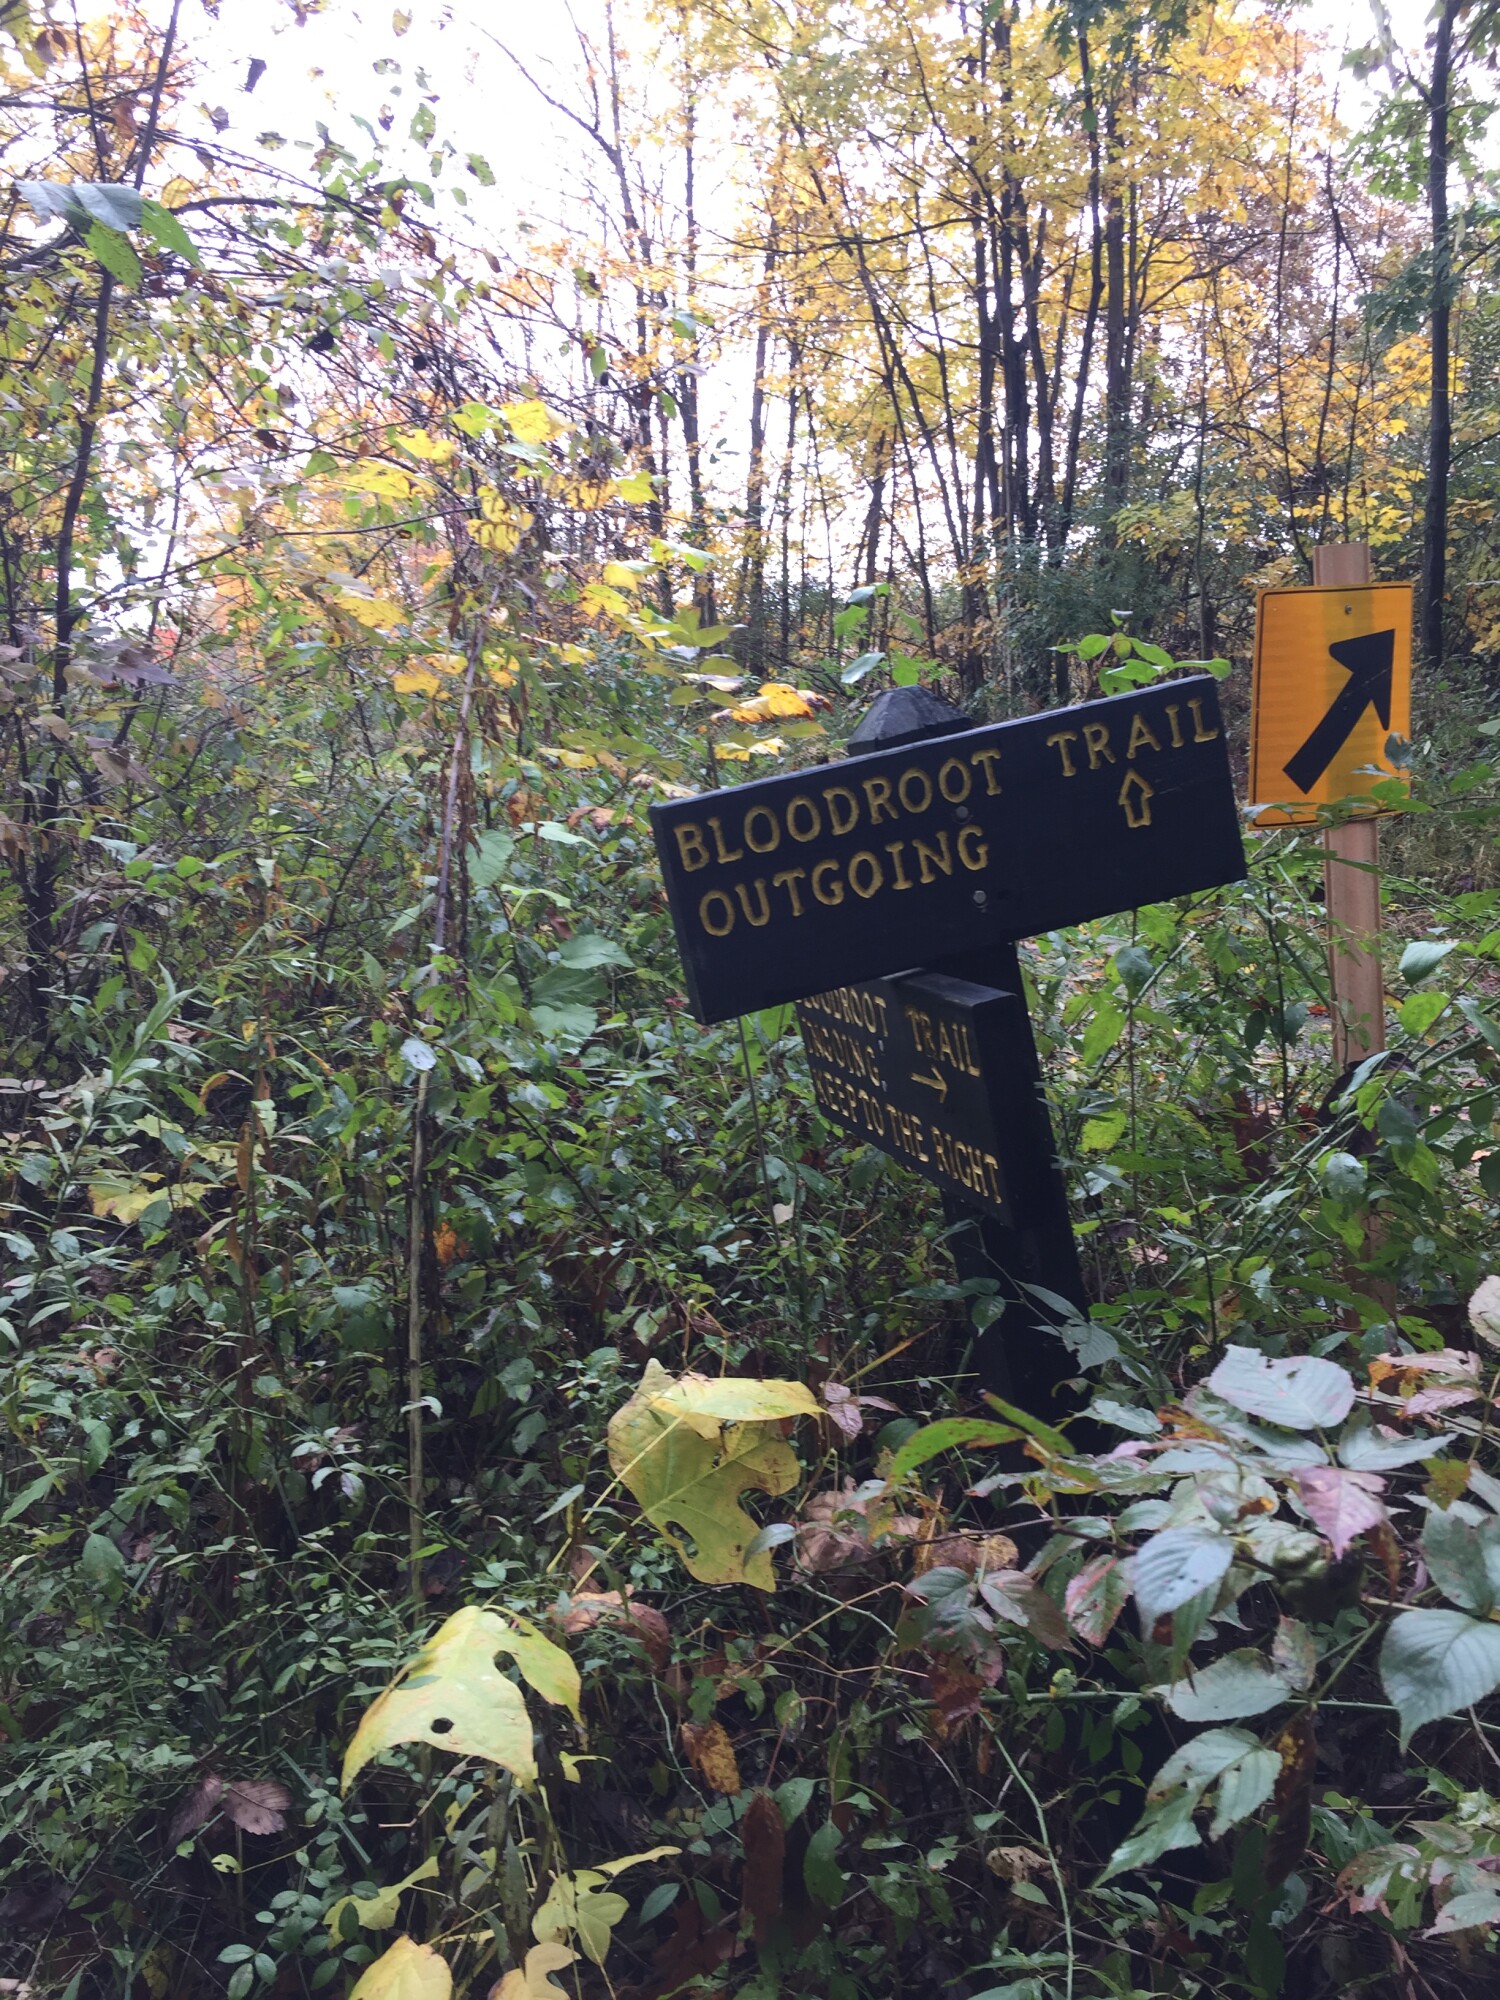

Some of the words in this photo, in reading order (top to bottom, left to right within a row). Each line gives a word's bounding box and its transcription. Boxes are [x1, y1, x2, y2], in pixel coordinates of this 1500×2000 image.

[673, 748, 1002, 873] BLOODROOT
[1046, 697, 1221, 777] TRAIL
[698, 825, 990, 937] OUTGOING
[905, 1005, 981, 1078] TRAIL
[813, 1068, 858, 1123] KEEP
[858, 1088, 885, 1137] TO
[886, 1103, 930, 1163] THE
[931, 1125, 1002, 1204] RIGHT
